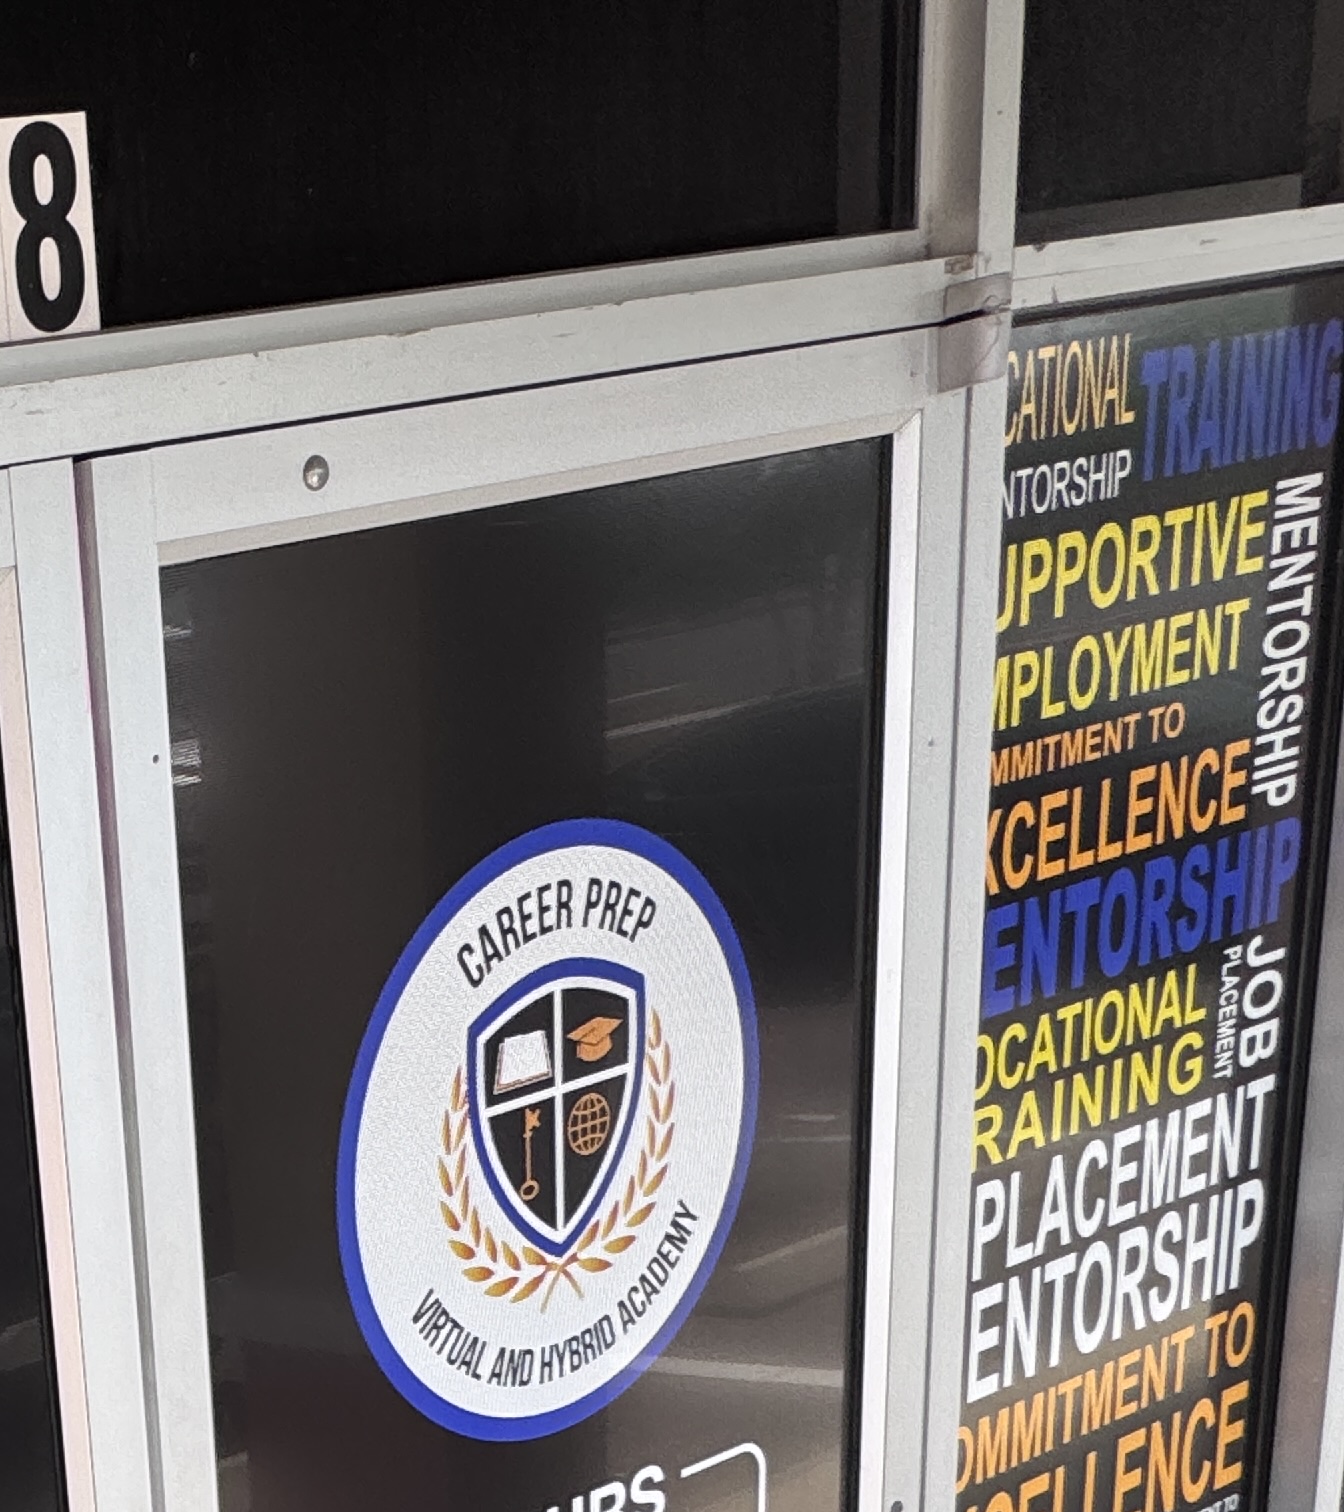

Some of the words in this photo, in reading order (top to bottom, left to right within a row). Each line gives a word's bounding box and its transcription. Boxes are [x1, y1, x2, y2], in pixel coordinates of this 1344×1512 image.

[1140, 318, 1342, 482] TRAINING
[1250, 471, 1324, 808] MENTORSHIP
[1148, 701, 1187, 744] TO
[457, 880, 574, 989] CAREER
[582, 878, 658, 944] PREP
[980, 816, 1302, 1020] ENTORSHIP
[1213, 944, 1243, 1079] PLACEMENT
[1238, 934, 1287, 1068] JOB
[970, 1030, 1205, 1174] RAINING
[970, 1073, 1276, 1282] PLACEMENT
[411, 1288, 482, 1382] VIRTUAL
[488, 1348, 534, 1388] AND
[539, 1313, 617, 1385] HYBRID
[617, 1200, 701, 1335] ACADEMY
[966, 1177, 1265, 1404] ENTORSHIP
[1204, 1301, 1255, 1378] TO
